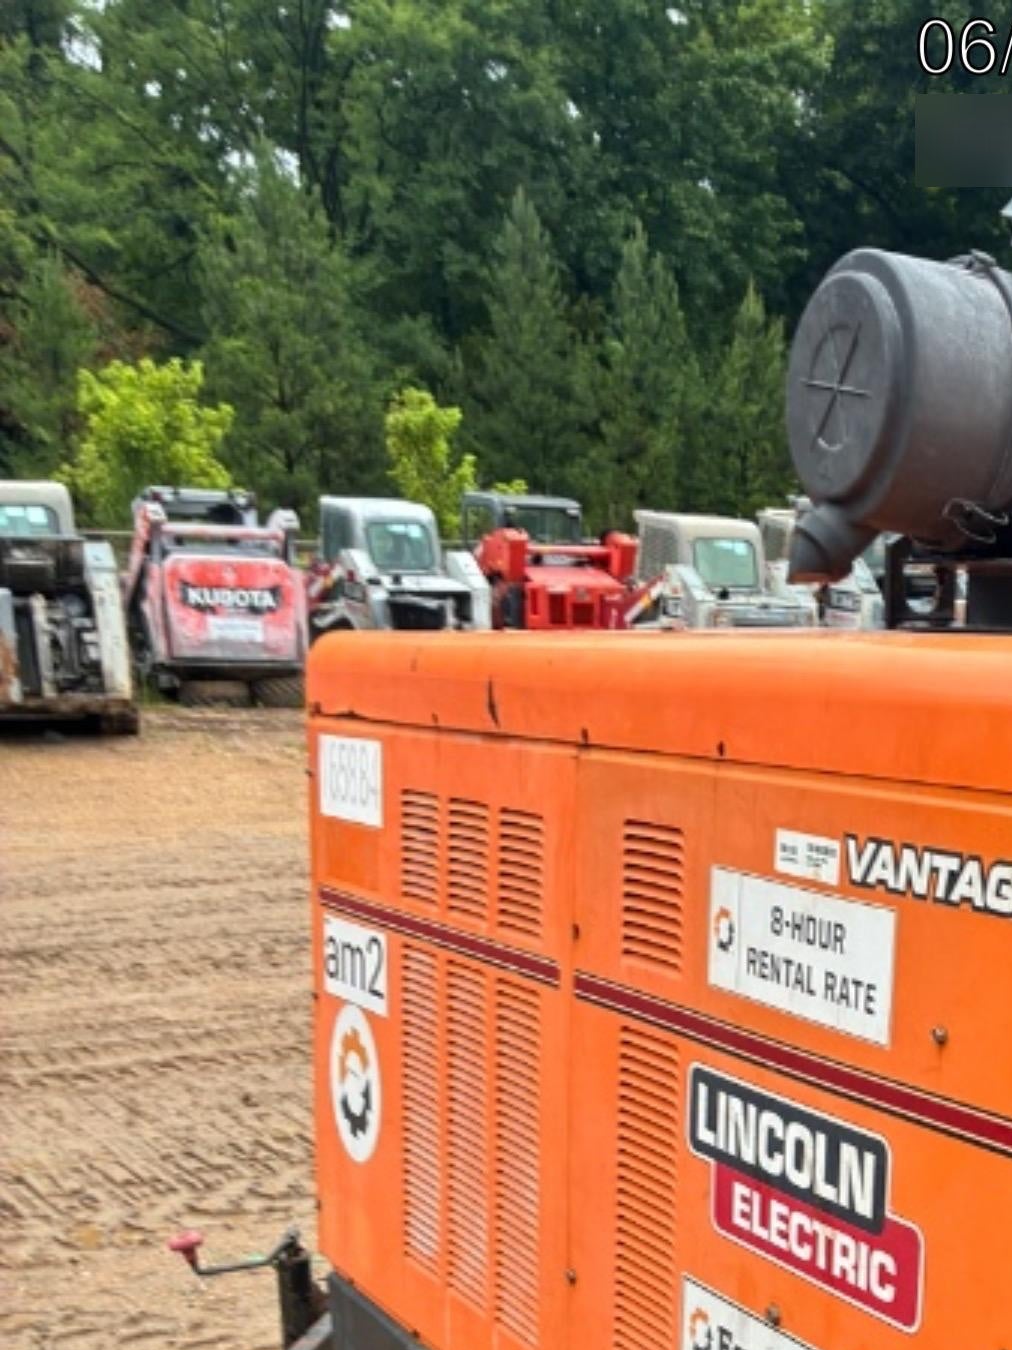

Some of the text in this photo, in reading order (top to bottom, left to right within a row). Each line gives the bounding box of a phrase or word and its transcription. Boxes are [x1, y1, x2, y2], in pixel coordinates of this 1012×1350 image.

[187, 587, 277, 608] KUBOTA
[770, 905, 846, 954] 8-HOUR
[747, 947, 877, 1016] RENTAL RATE
[696, 1081, 877, 1219] LINCOLN
[731, 1181, 897, 1302] ELECTRIC
